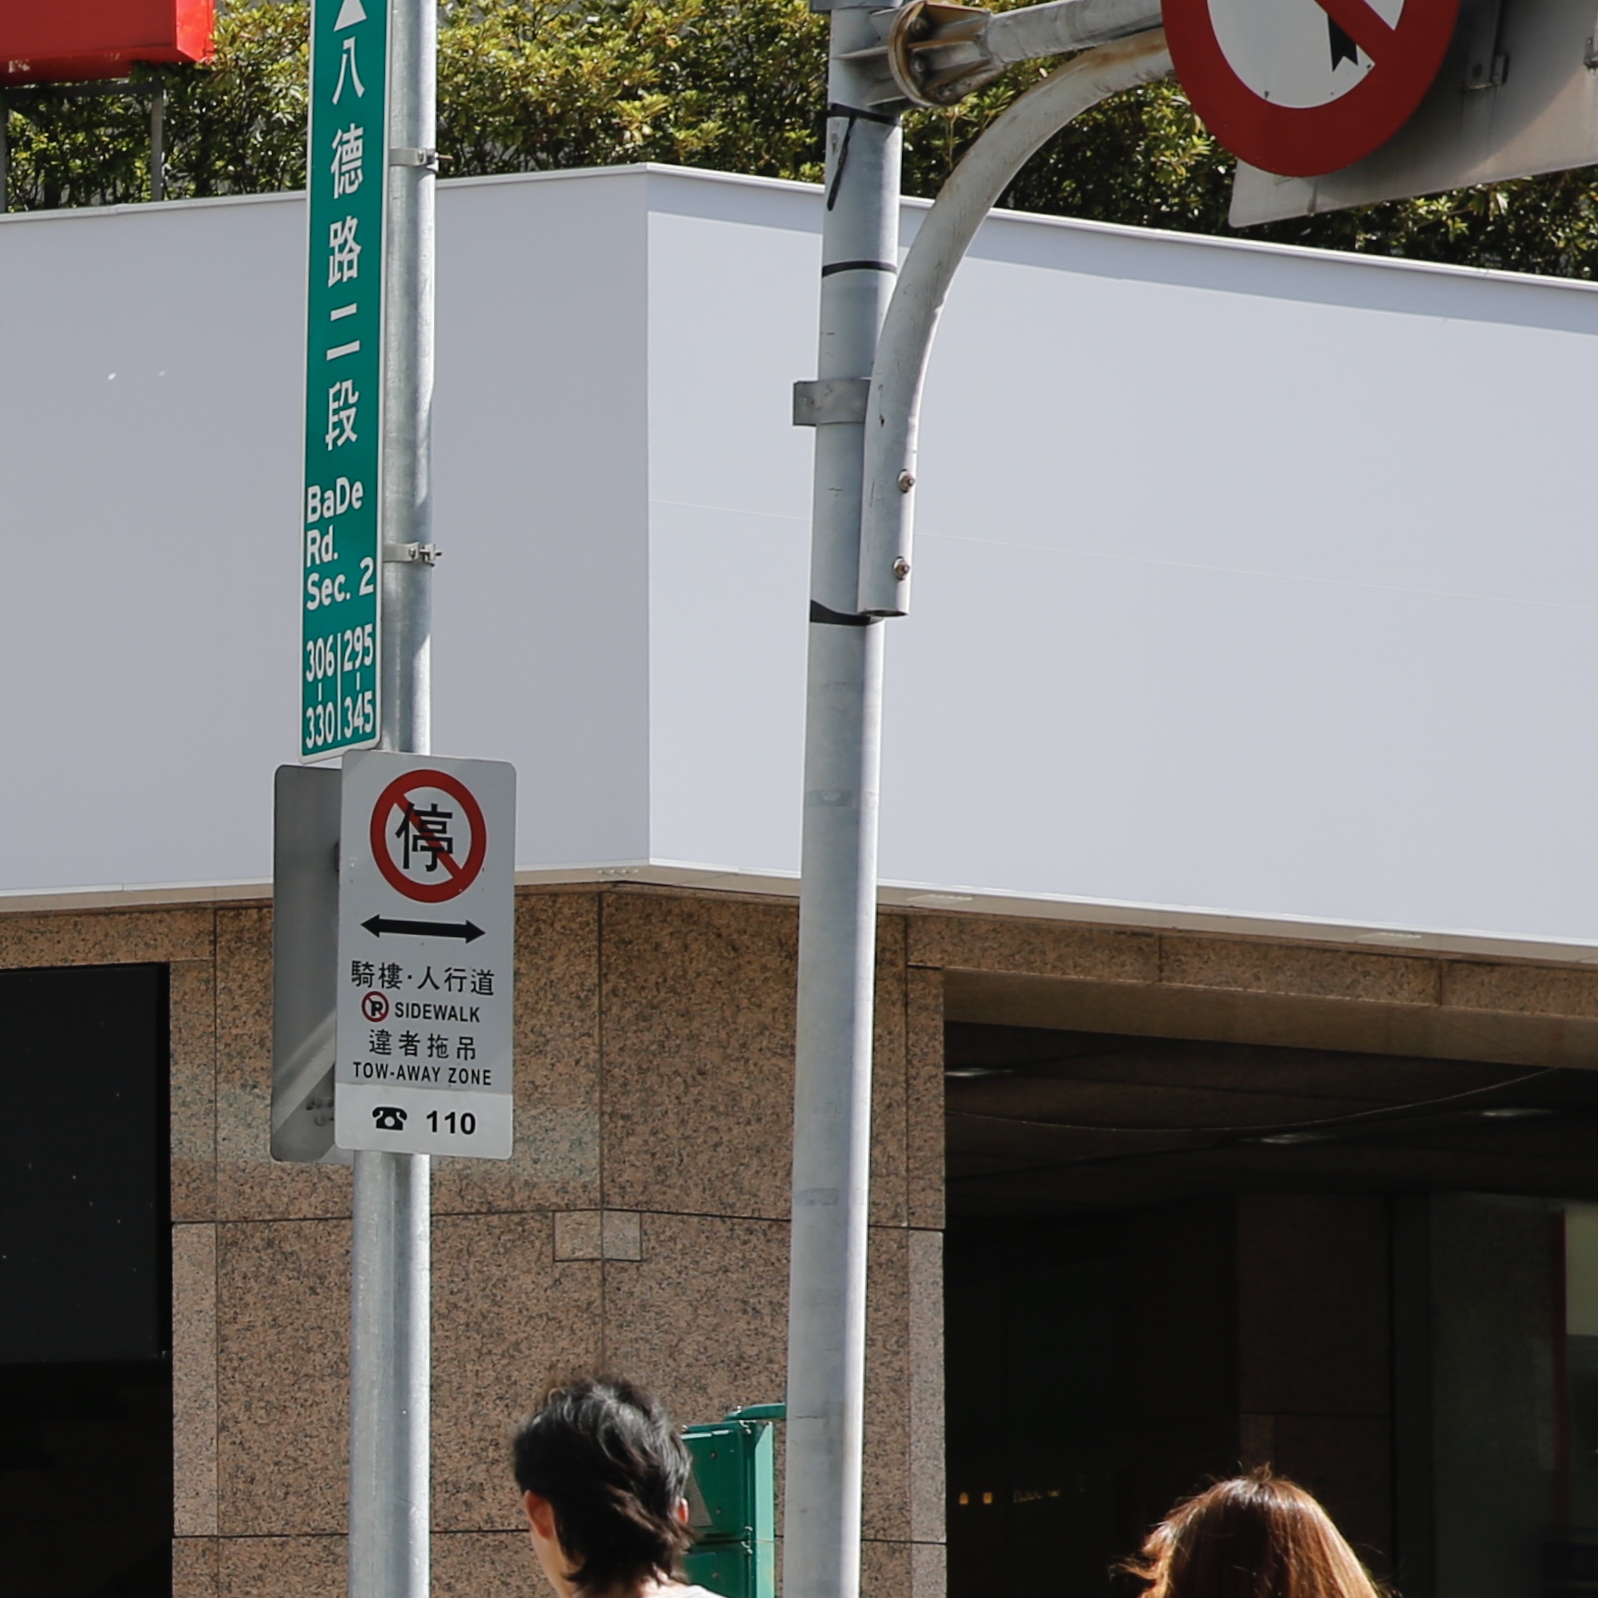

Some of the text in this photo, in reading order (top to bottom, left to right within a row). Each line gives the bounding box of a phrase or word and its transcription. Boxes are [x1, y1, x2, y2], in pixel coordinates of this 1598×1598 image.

[325, 36, 365, 451] 八德路二段
[307, 477, 364, 523] BaDe
[307, 525, 338, 567] Rd.
[307, 557, 374, 611] Sec. 2
[306, 623, 373, 682] 306 295
[306, 691, 373, 749] 330 345
[395, 803, 454, 872] 停
[394, 1002, 481, 1023] SIDEWALK
[369, 1029, 476, 1062] 違者拖吊
[353, 1062, 492, 1086] TOW-AWAY ZONE
[426, 1109, 476, 1136] 110
